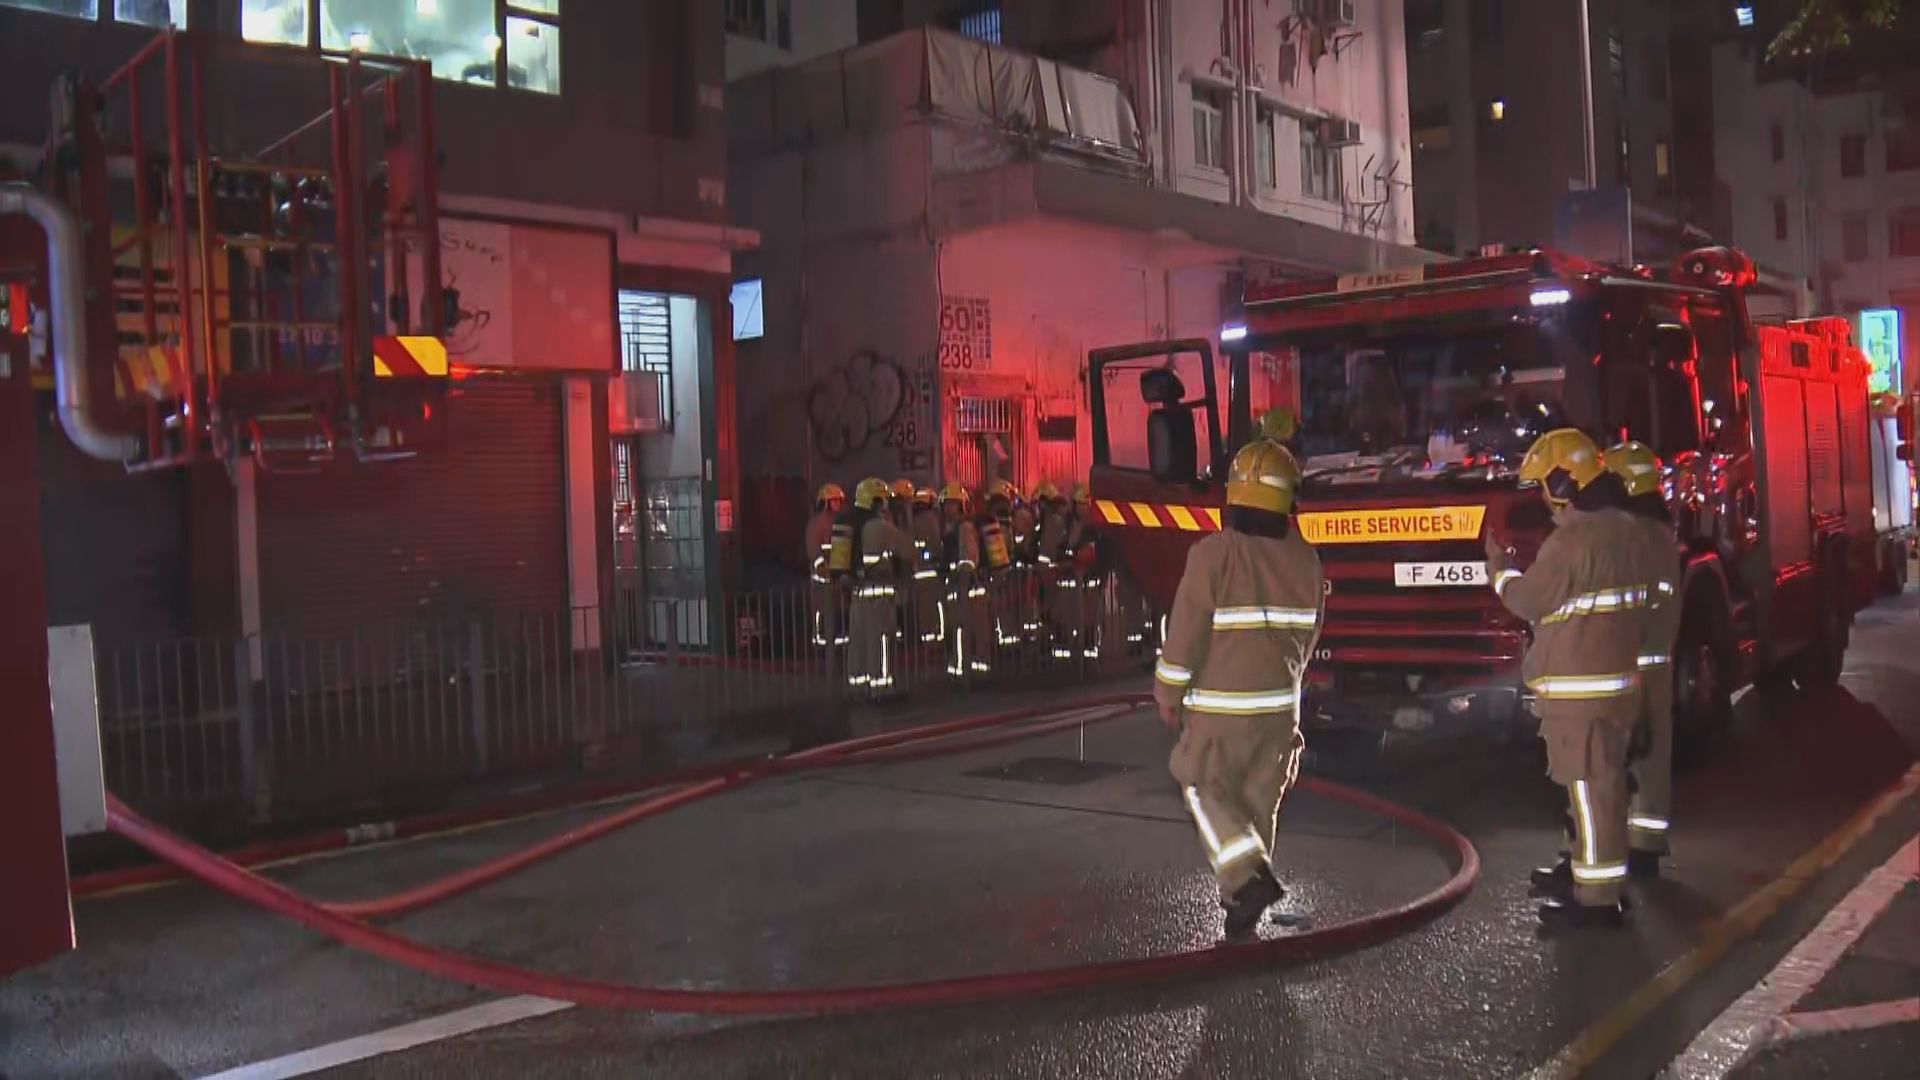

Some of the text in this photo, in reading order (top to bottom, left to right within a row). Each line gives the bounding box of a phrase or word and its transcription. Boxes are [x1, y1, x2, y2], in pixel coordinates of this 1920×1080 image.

[940, 343, 972, 369] 238
[1325, 514, 1453, 536] FIRE SERVICES
[1412, 565, 1474, 583] F 468
